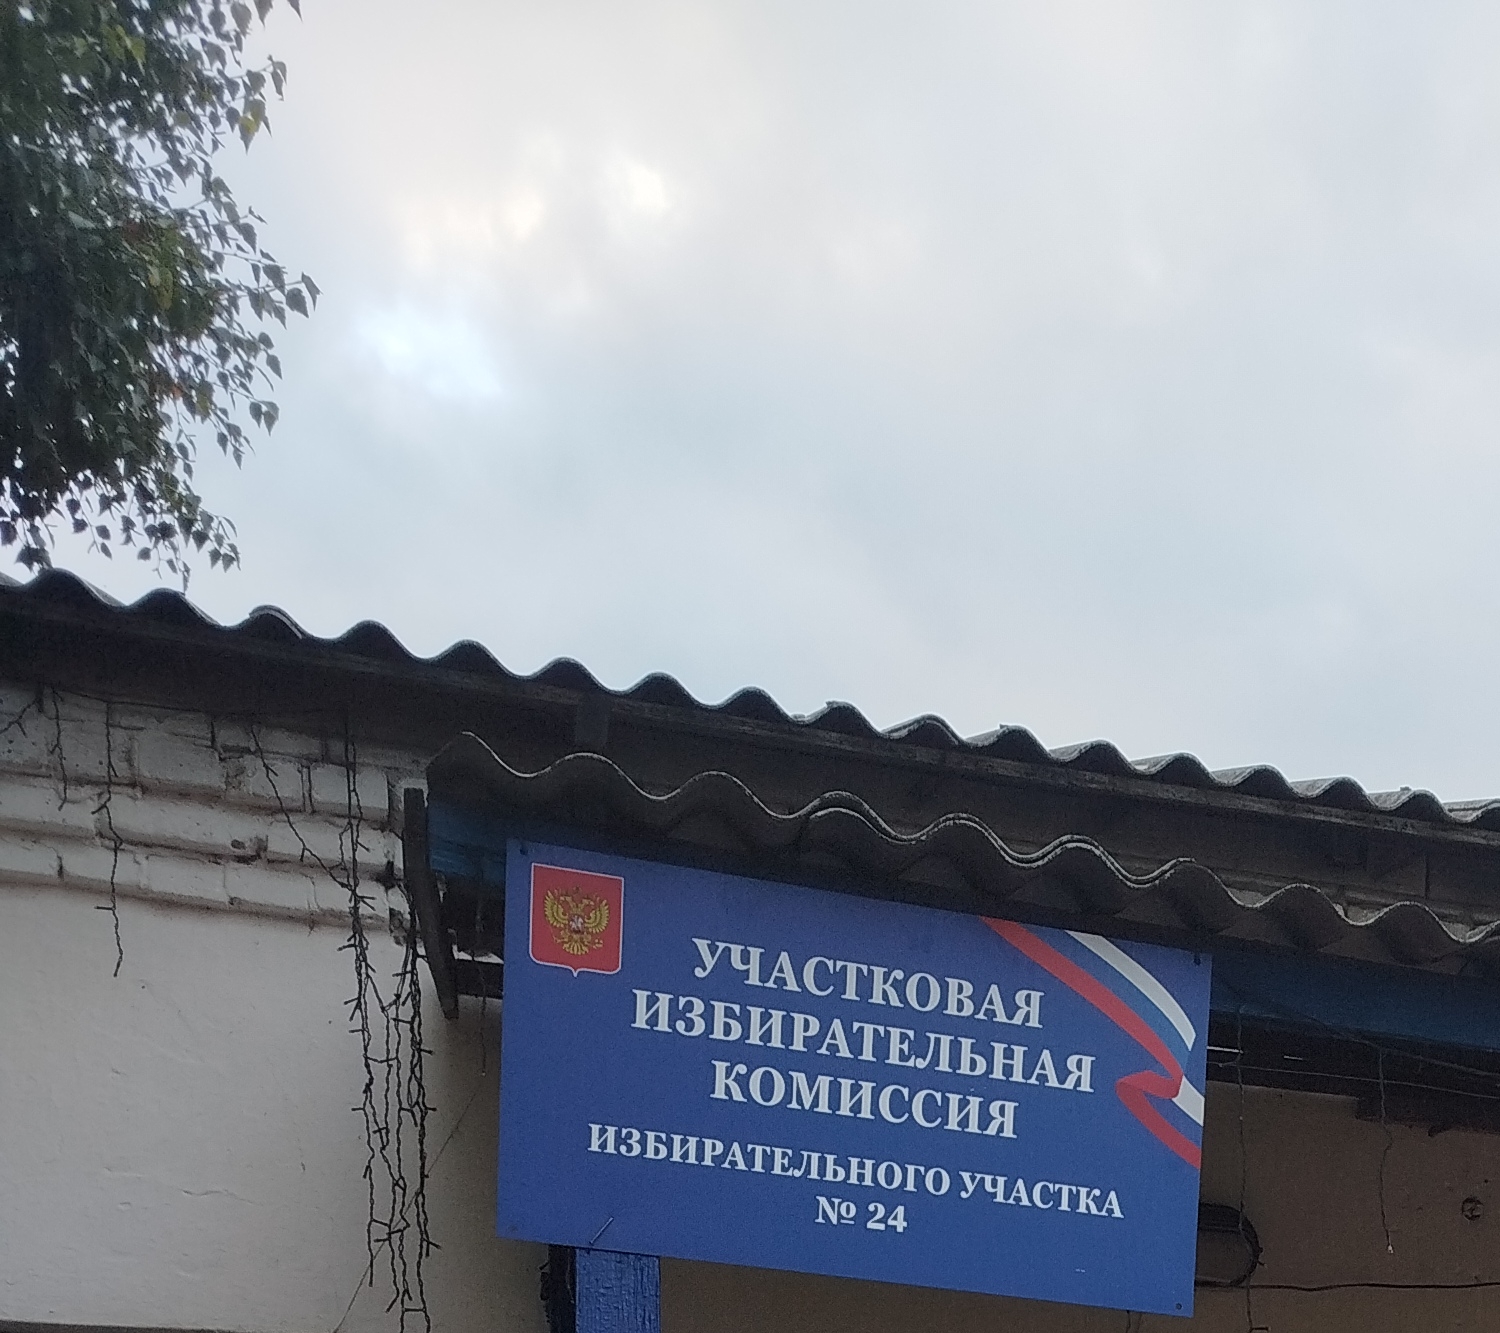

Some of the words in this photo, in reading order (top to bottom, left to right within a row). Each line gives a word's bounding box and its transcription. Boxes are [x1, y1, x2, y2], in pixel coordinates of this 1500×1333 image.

[691, 937, 1044, 1029] УЧАСТКОВАЯ
[630, 988, 1096, 1094] ИЗБИРАТЕЛЬНАЯ
[709, 1060, 1019, 1139] КОМИССИЯ
[586, 1123, 951, 1196] ИЗБИРАТЕЛЬНОГО
[959, 1170, 1125, 1219] УЧАСТКА
[814, 1195, 857, 1226] №
[866, 1203, 908, 1233] 24
